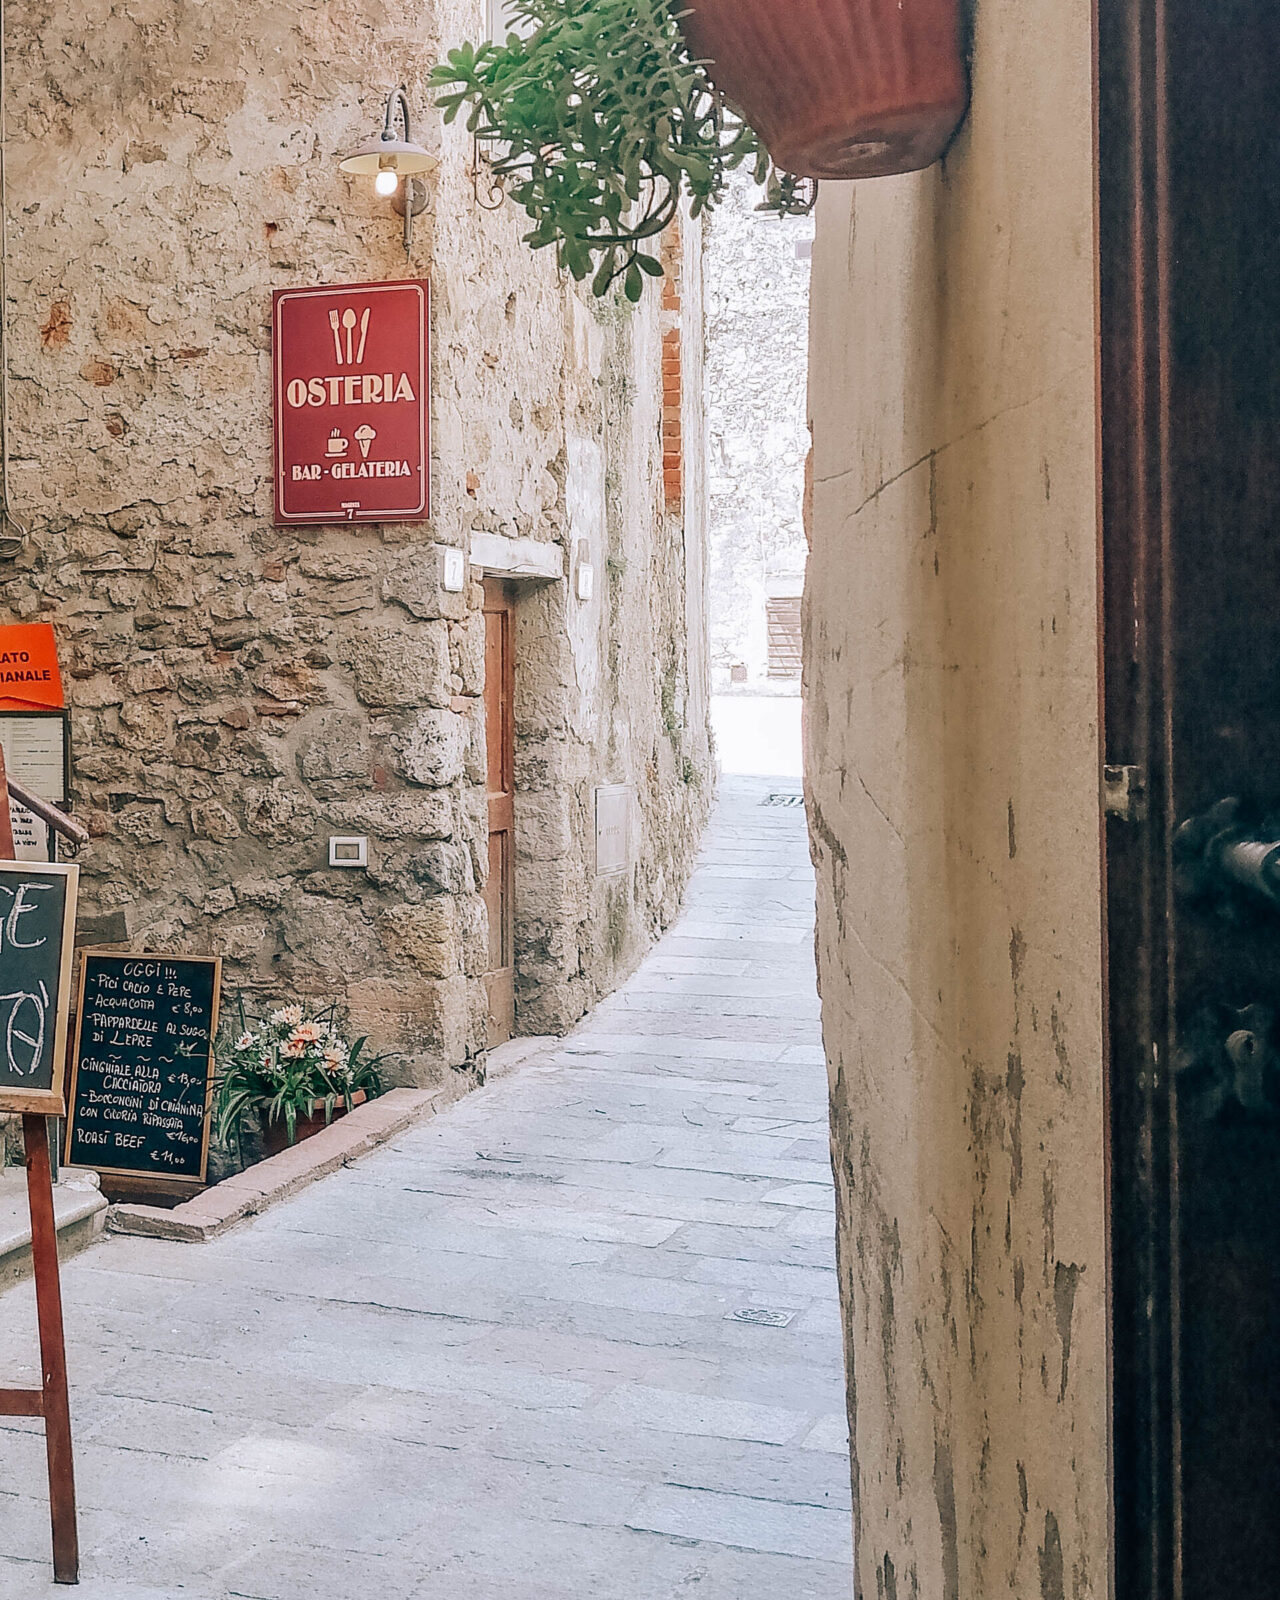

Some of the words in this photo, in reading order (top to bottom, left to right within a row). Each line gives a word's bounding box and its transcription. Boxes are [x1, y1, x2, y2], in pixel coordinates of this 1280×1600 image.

[286, 373, 415, 408] OSTERIA
[292, 464, 322, 481] BAR
[331, 461, 411, 479] GELATERIA
[346, 508, 354, 520] 7
[167, 982, 192, 999] PEPE
[109, 1030, 154, 1048] LEPRE
[134, 1065, 160, 1080] ALLA
[80, 1106, 98, 1118] CON
[142, 1112, 184, 1130] RIPASSATA
[77, 1128, 111, 1145] ROAST
[114, 1132, 146, 1149] BEEF
